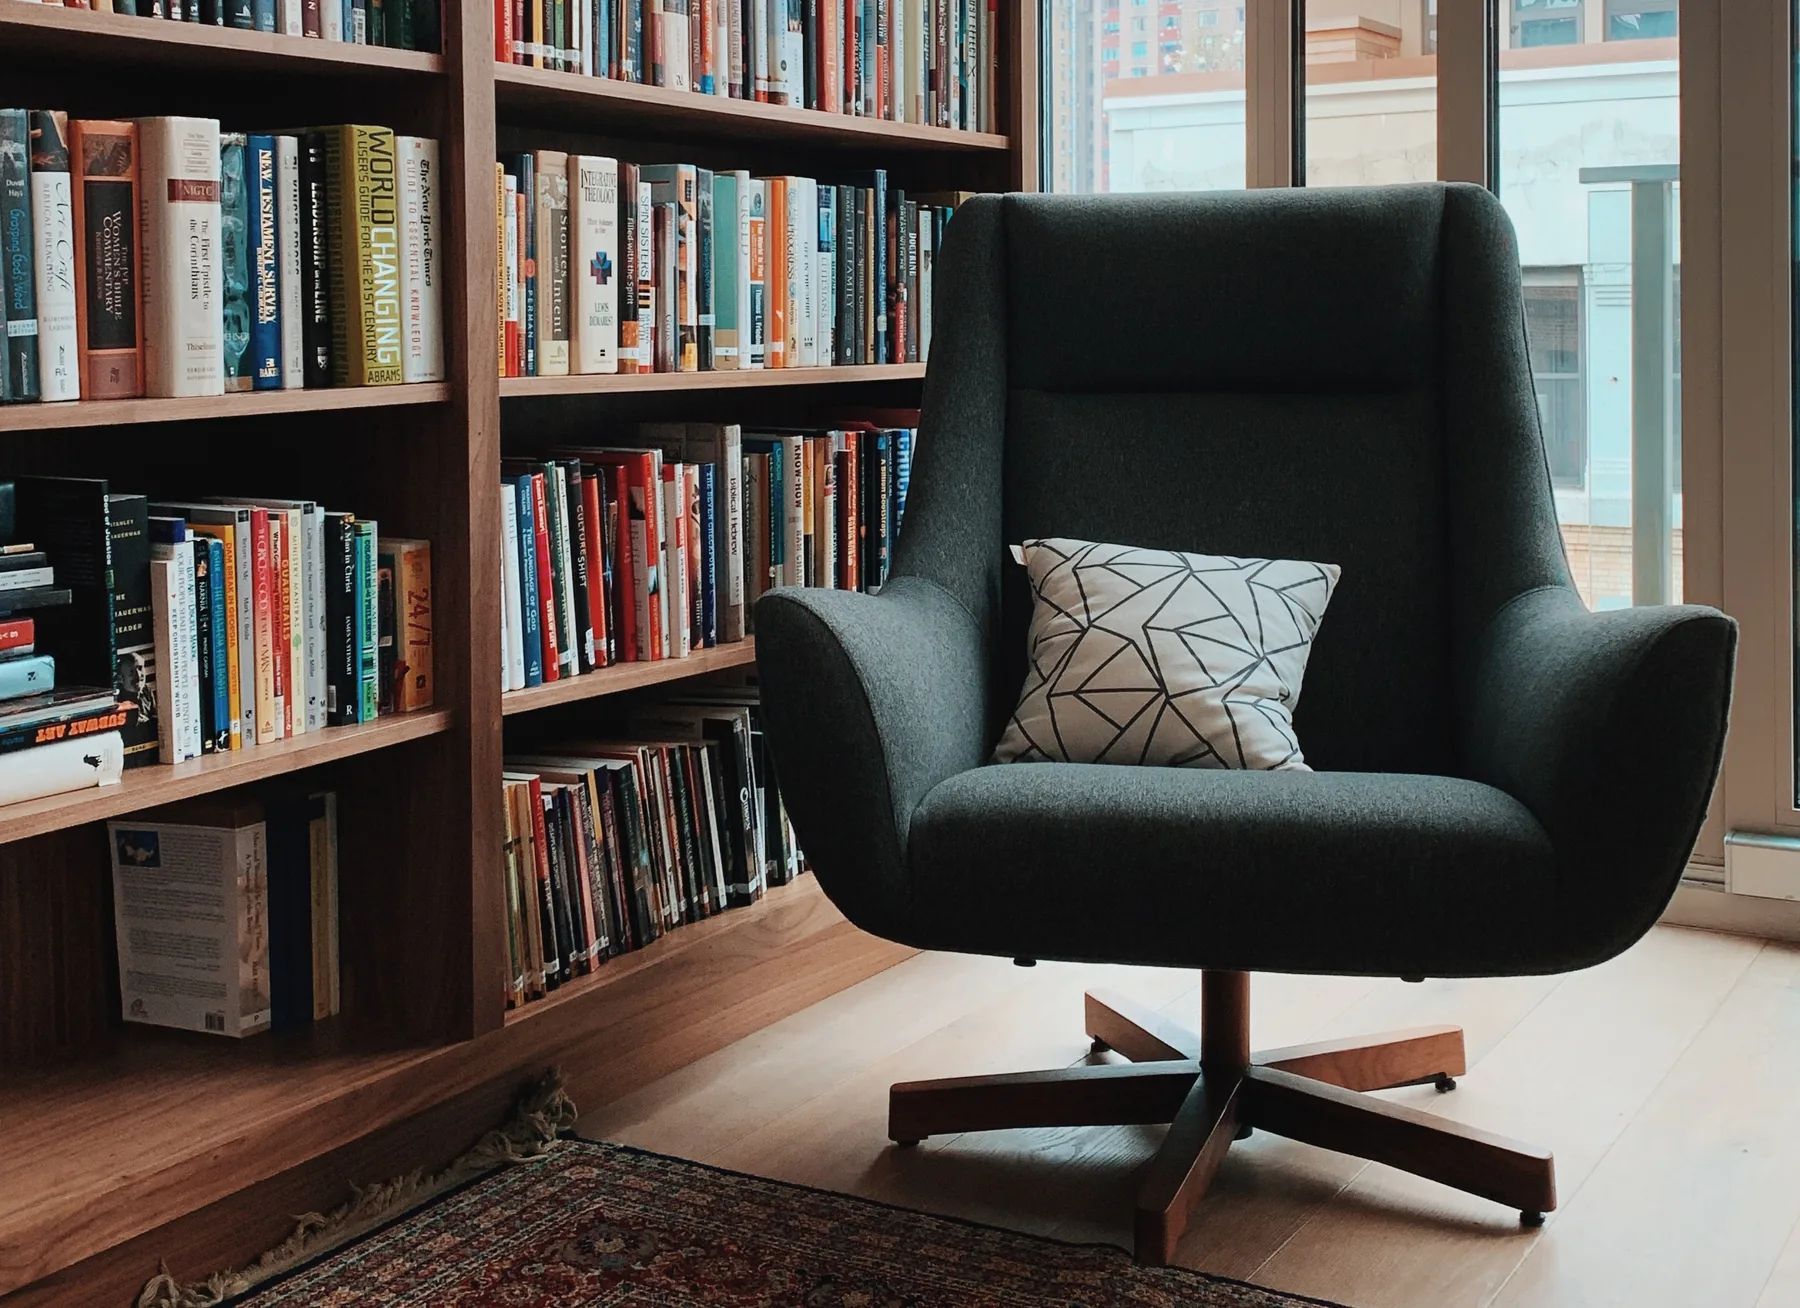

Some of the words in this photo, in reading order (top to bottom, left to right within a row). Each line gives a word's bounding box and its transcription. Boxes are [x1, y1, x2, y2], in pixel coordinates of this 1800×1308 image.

[357, 129, 367, 138] A
[260, 150, 272, 181] NEW
[358, 141, 368, 182] USER'S
[406, 158, 416, 194] GUIDE
[419, 159, 430, 185] The
[359, 185, 370, 222] GUIDE
[408, 201, 417, 215] TO
[420, 187, 431, 212] New
[585, 187, 615, 204] THEOLOGY
[640, 195, 649, 224] SPIN
[8, 209, 25, 252] Grasping
[190, 219, 198, 232] the
[201, 219, 209, 233] The
[261, 185, 275, 267] TESTAMENT
[311, 182, 325, 270] LEADERSHIP
[361, 226, 371, 248] FOR
[420, 215, 432, 245] York
[626, 217, 635, 241] Filled
[740, 195, 749, 256] CREED
[846, 227, 854, 251] THE
[112, 210, 122, 277] WOMEN'S
[201, 237, 210, 261] First
[409, 221, 419, 282] ESSENTIAL
[560, 215, 568, 277] Stories
[627, 242, 635, 263] with
[640, 228, 649, 278] SISTERS
[786, 223, 795, 280] PROGRESS
[908, 232, 917, 277] DOCTRINE
[103, 215, 114, 313] COMMENTARY
[190, 235, 200, 300] Corinthians
[362, 252, 372, 275] THE
[423, 248, 433, 287] Times
[627, 264, 635, 280] the
[14, 282, 29, 310] Word
[200, 264, 211, 299] Epistle
[264, 269, 277, 323] SURVEY
[363, 278, 374, 307] 21ST
[625, 281, 635, 304] Spirit
[846, 259, 854, 309] FAMILY
[113, 282, 123, 320] BIBLE
[203, 301, 209, 310] to
[314, 291, 327, 324] LINE
[553, 278, 563, 334] Intent
[365, 309, 377, 363] CENTURY
[410, 288, 421, 359] KNOWLEDGE
[367, 370, 400, 384] ABRAMS
[794, 444, 802, 508] KNOW-HOW
[729, 477, 738, 513] Biblical
[508, 501, 516, 544] blink
[879, 493, 887, 538] Bootstraps
[344, 532, 353, 553] Man
[526, 527, 534, 545] THE
[730, 517, 738, 556] Hebrew
[291, 535, 299, 578] MINISTRY
[345, 554, 353, 564] in
[527, 547, 535, 592] LANGUAGE
[272, 572, 281, 593] Wrong
[345, 565, 355, 593] Christ
[282, 559, 291, 641] GUARDRAILS
[407, 588, 433, 646] 24/7
[530, 595, 536, 607] OF
[228, 604, 236, 649] GEORGIA
[36, 724, 67, 744] ART
[68, 711, 127, 736] SUBWAY
